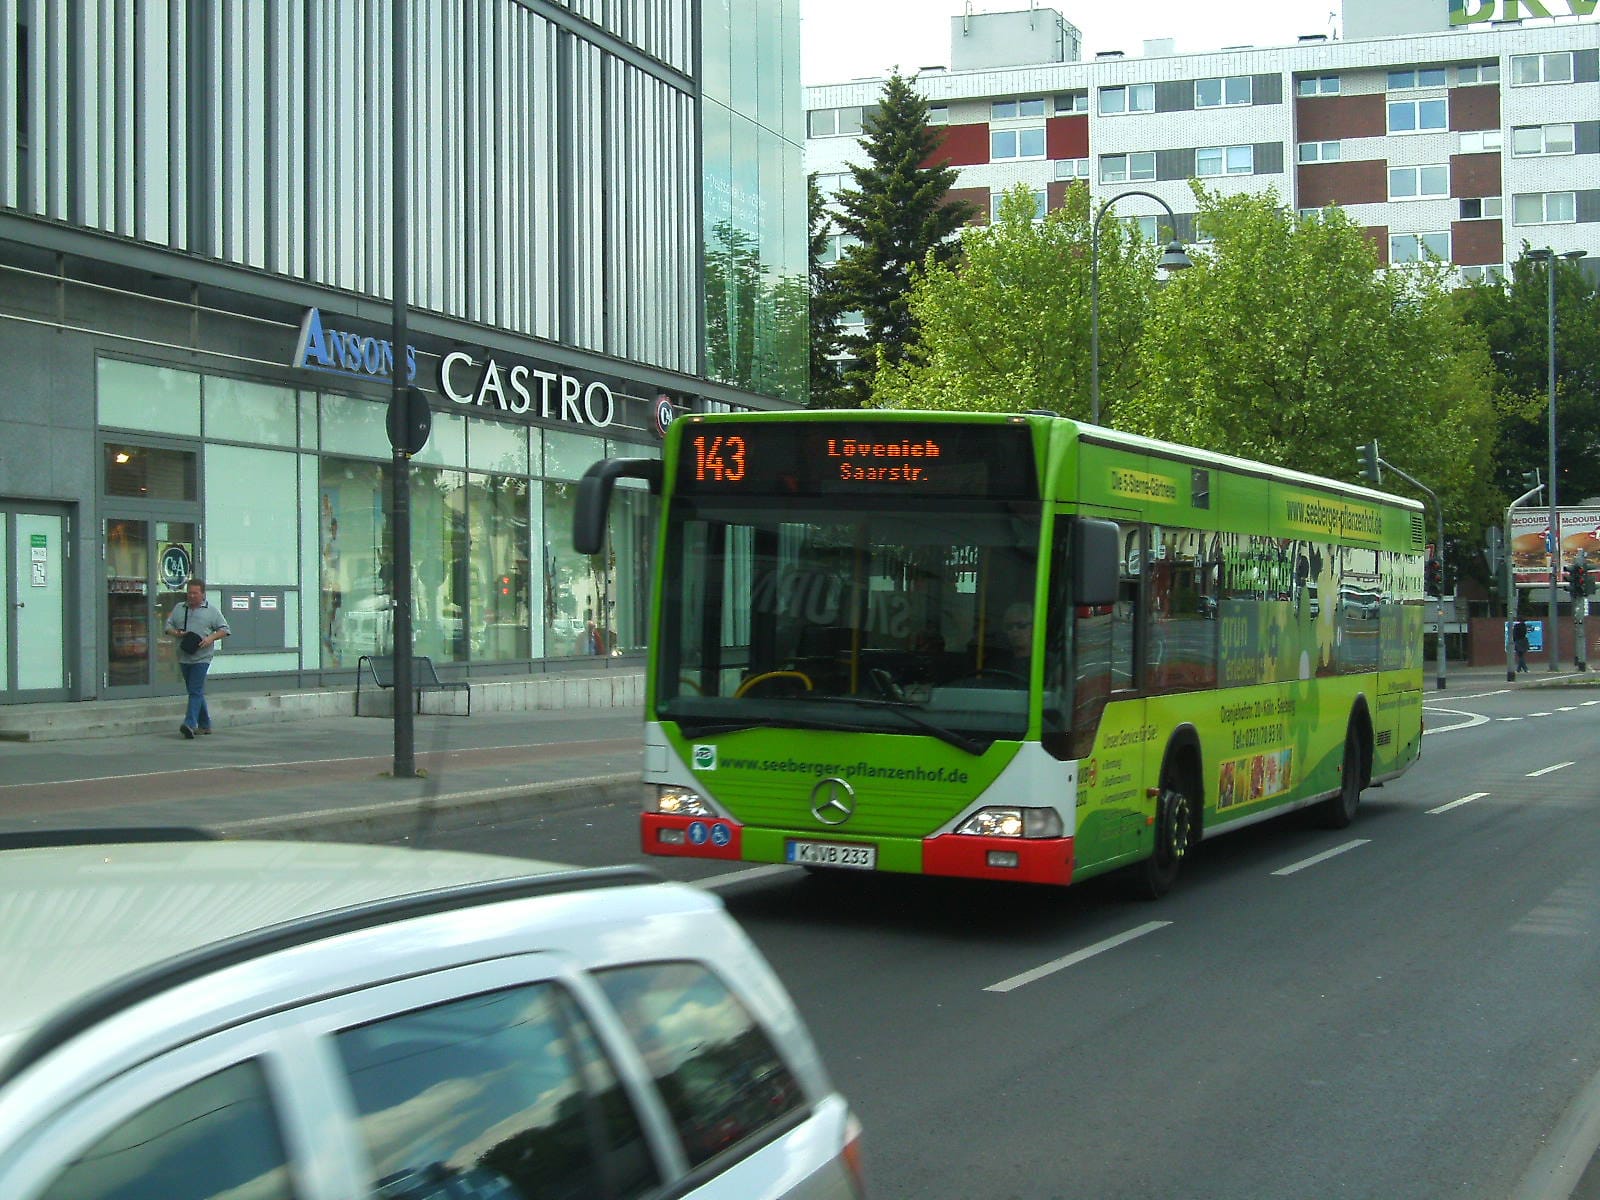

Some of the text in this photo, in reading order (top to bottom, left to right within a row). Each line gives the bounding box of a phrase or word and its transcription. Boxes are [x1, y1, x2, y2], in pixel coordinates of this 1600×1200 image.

[440, 351, 614, 428] CASTRO
[827, 439, 941, 457] Lövenich
[693, 436, 747, 481] 143
[839, 462, 928, 481] Saarstr.
[1511, 515, 1550, 524] McDOUBL
[1562, 515, 1600, 524] McDOUBL
[164, 556, 186, 577] C&A
[720, 757, 968, 784] www.seeberger-pflanzenhof.de
[841, 847, 869, 865] 233
